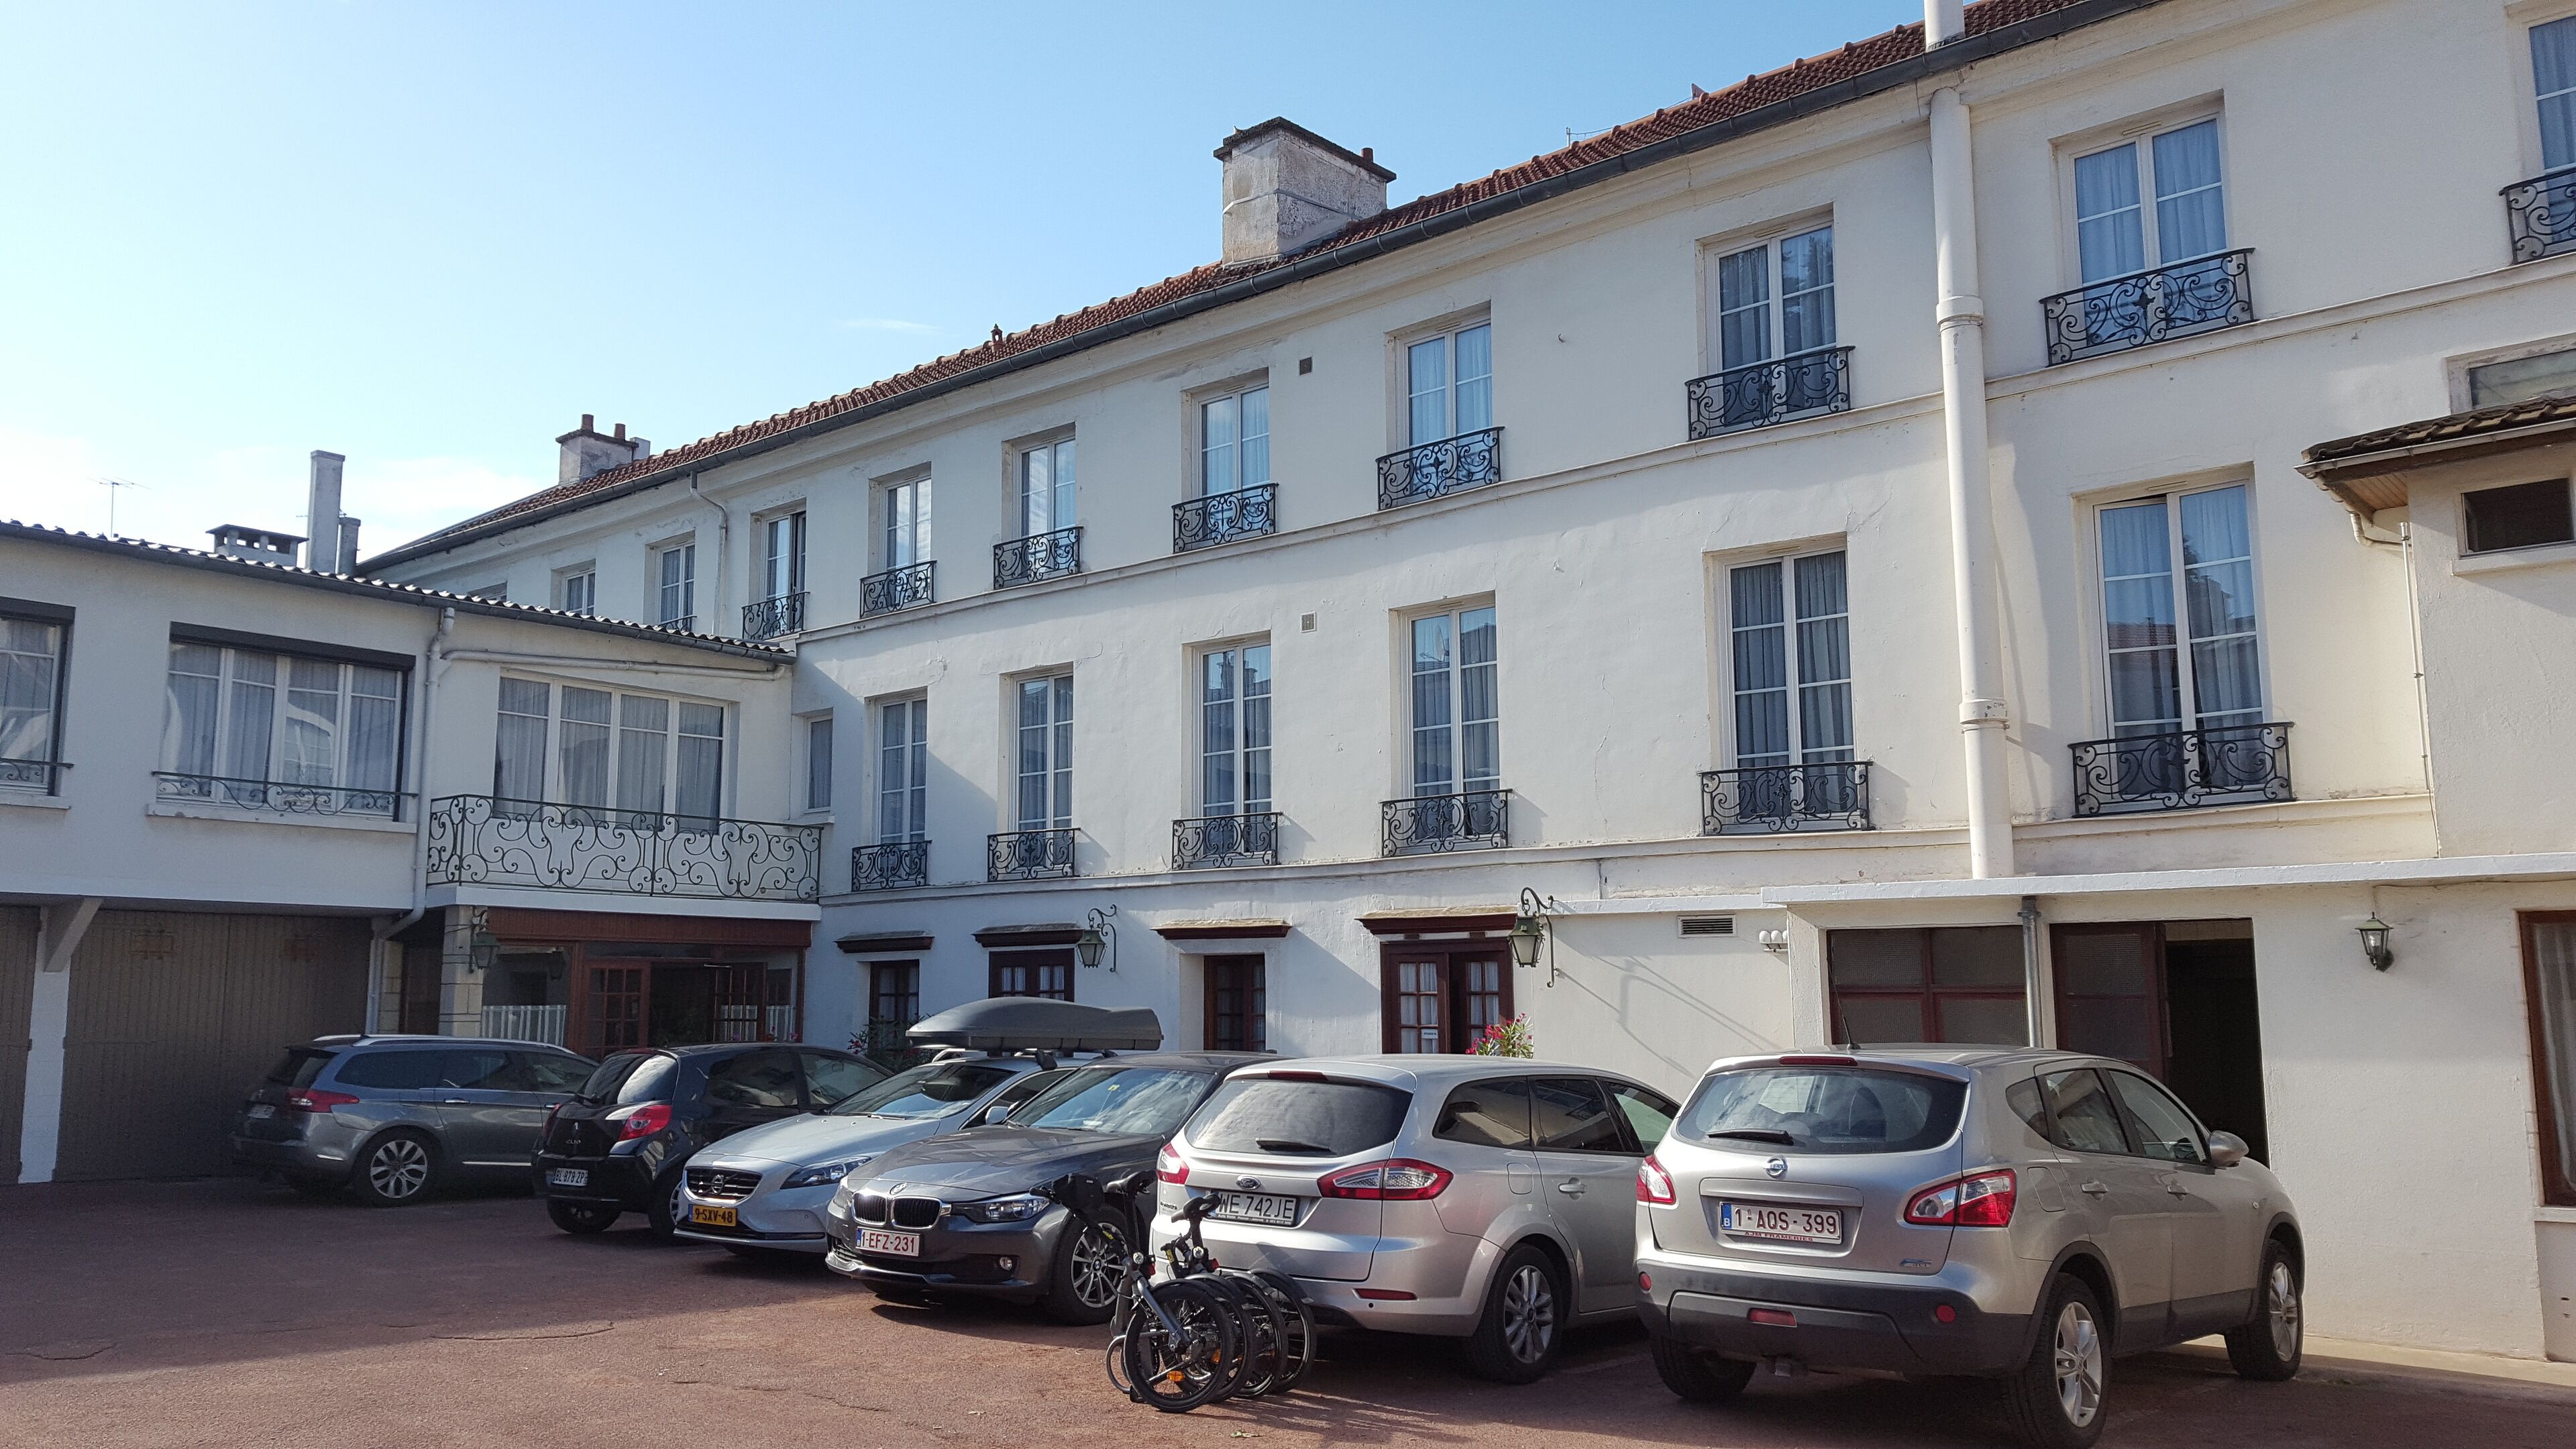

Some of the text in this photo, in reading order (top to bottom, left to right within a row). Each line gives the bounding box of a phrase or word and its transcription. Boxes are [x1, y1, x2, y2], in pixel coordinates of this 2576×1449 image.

[694, 1208, 733, 1223] 9-SXV-48
[1244, 1195, 1294, 1219] 742JE
[1724, 1208, 1837, 1234] B 1-AQS-399
[861, 1232, 915, 1253] 1-EFZ-231
